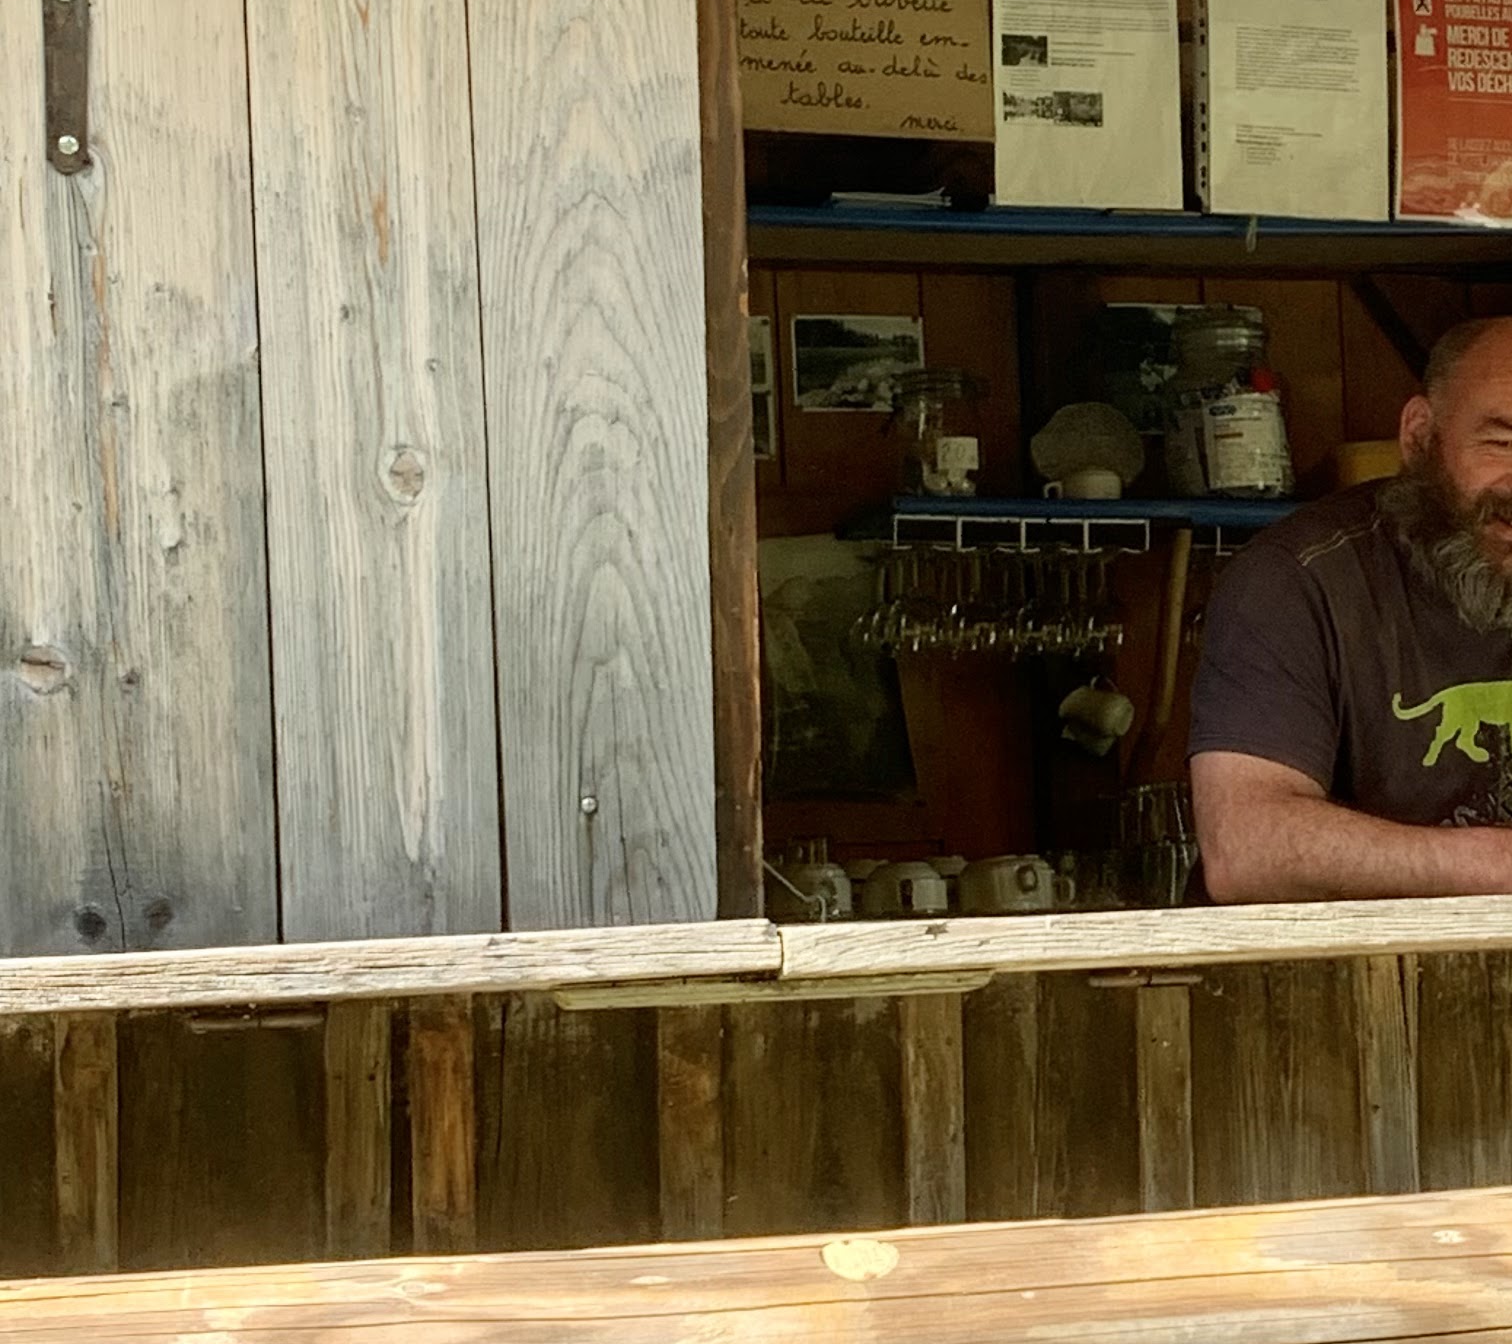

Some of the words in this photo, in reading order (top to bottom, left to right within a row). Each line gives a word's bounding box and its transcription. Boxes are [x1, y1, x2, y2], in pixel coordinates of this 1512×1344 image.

[739, 17, 790, 42] toute
[807, 13, 904, 45] bouteille
[1446, 24, 1490, 47] MERCI
[1491, 27, 1510, 48] DE
[739, 49, 817, 74] menée
[955, 63, 988, 84] des
[1447, 70, 1475, 92] VOS
[780, 80, 870, 109] tables.
